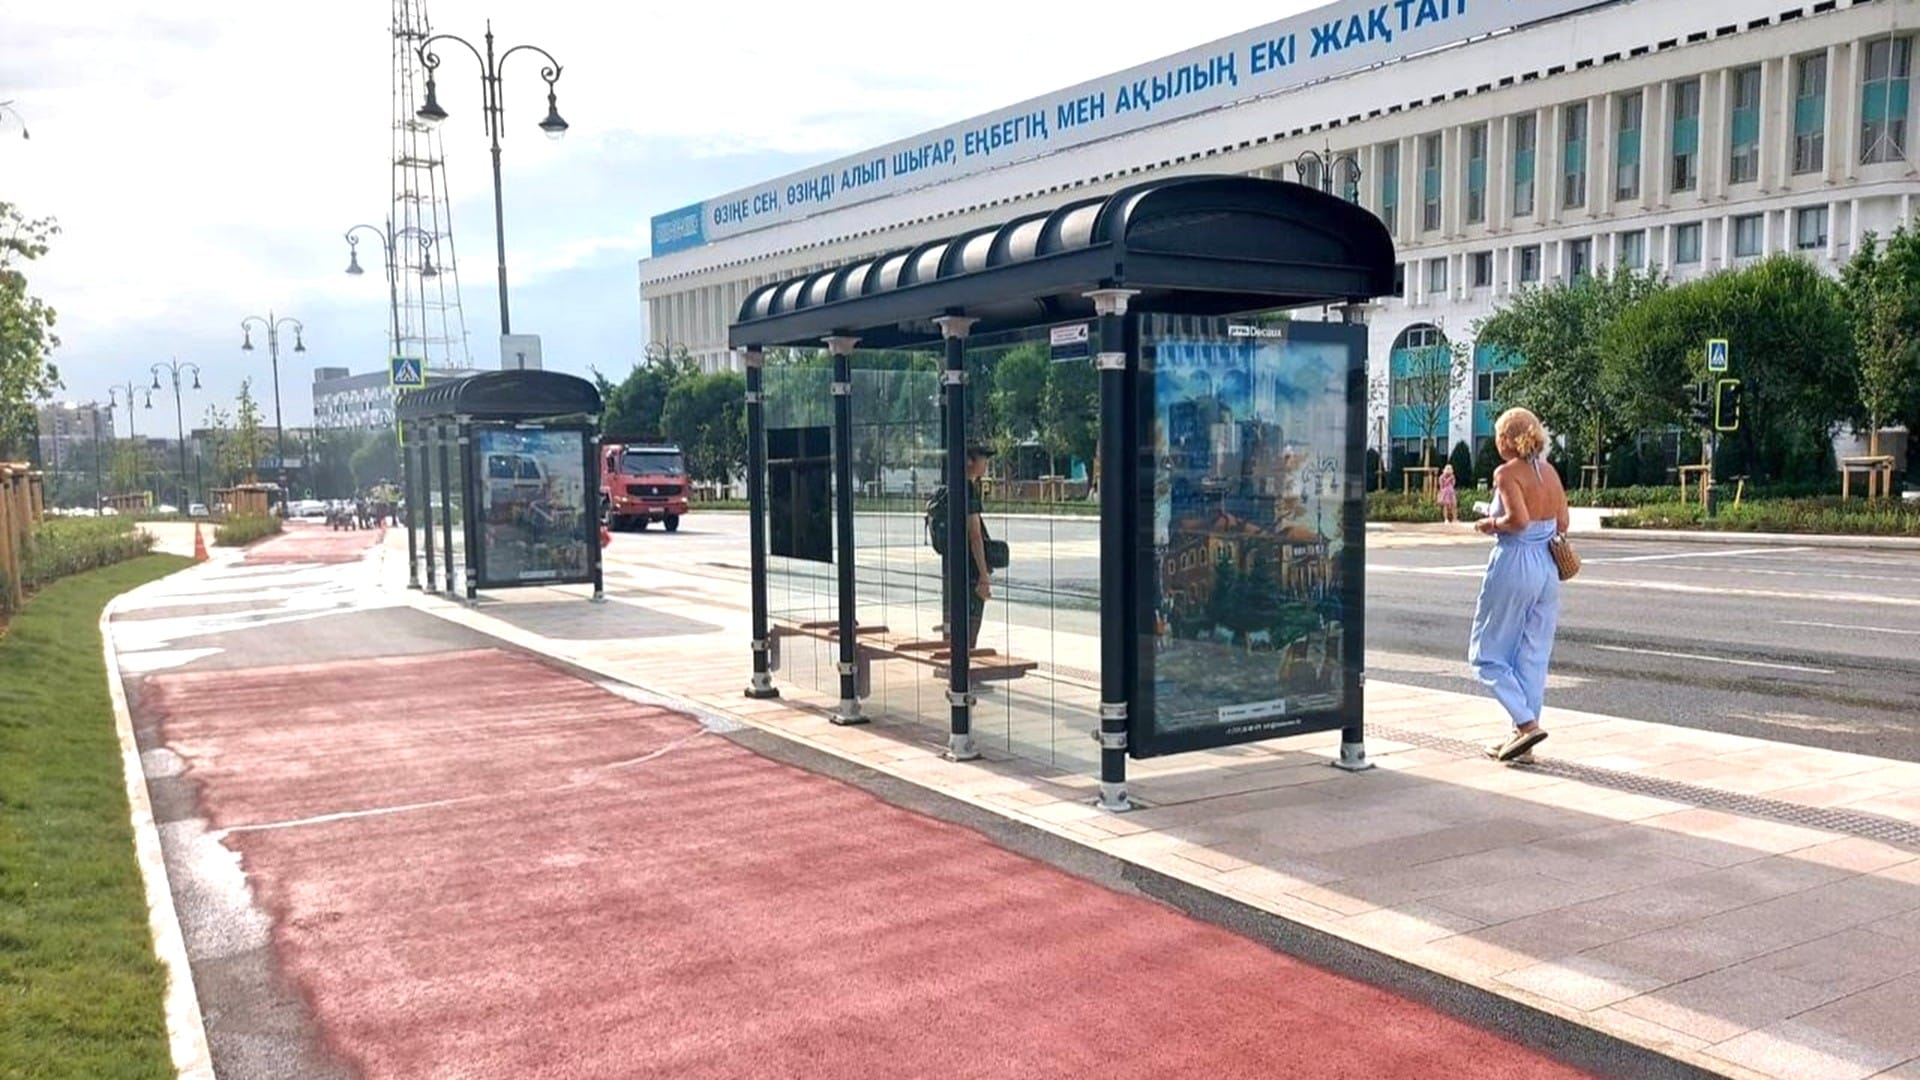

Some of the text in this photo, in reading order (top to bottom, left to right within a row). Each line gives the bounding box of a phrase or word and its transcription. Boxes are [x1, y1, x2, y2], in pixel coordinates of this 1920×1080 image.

[713, 199, 749, 225] ӨЗІҢЕ
[753, 192, 782, 213] СЕН,
[786, 174, 835, 205] ӨЗІҢДІ
[840, 158, 887, 191] АЛЫП
[892, 139, 957, 176] ШЫҒАР,
[964, 110, 1048, 156] ЕҢБЕГІҢ
[1057, 92, 1105, 130] МЕН
[1115, 52, 1238, 114] АҚЫЛЫҢ
[1250, 34, 1296, 74] ЕКІ
